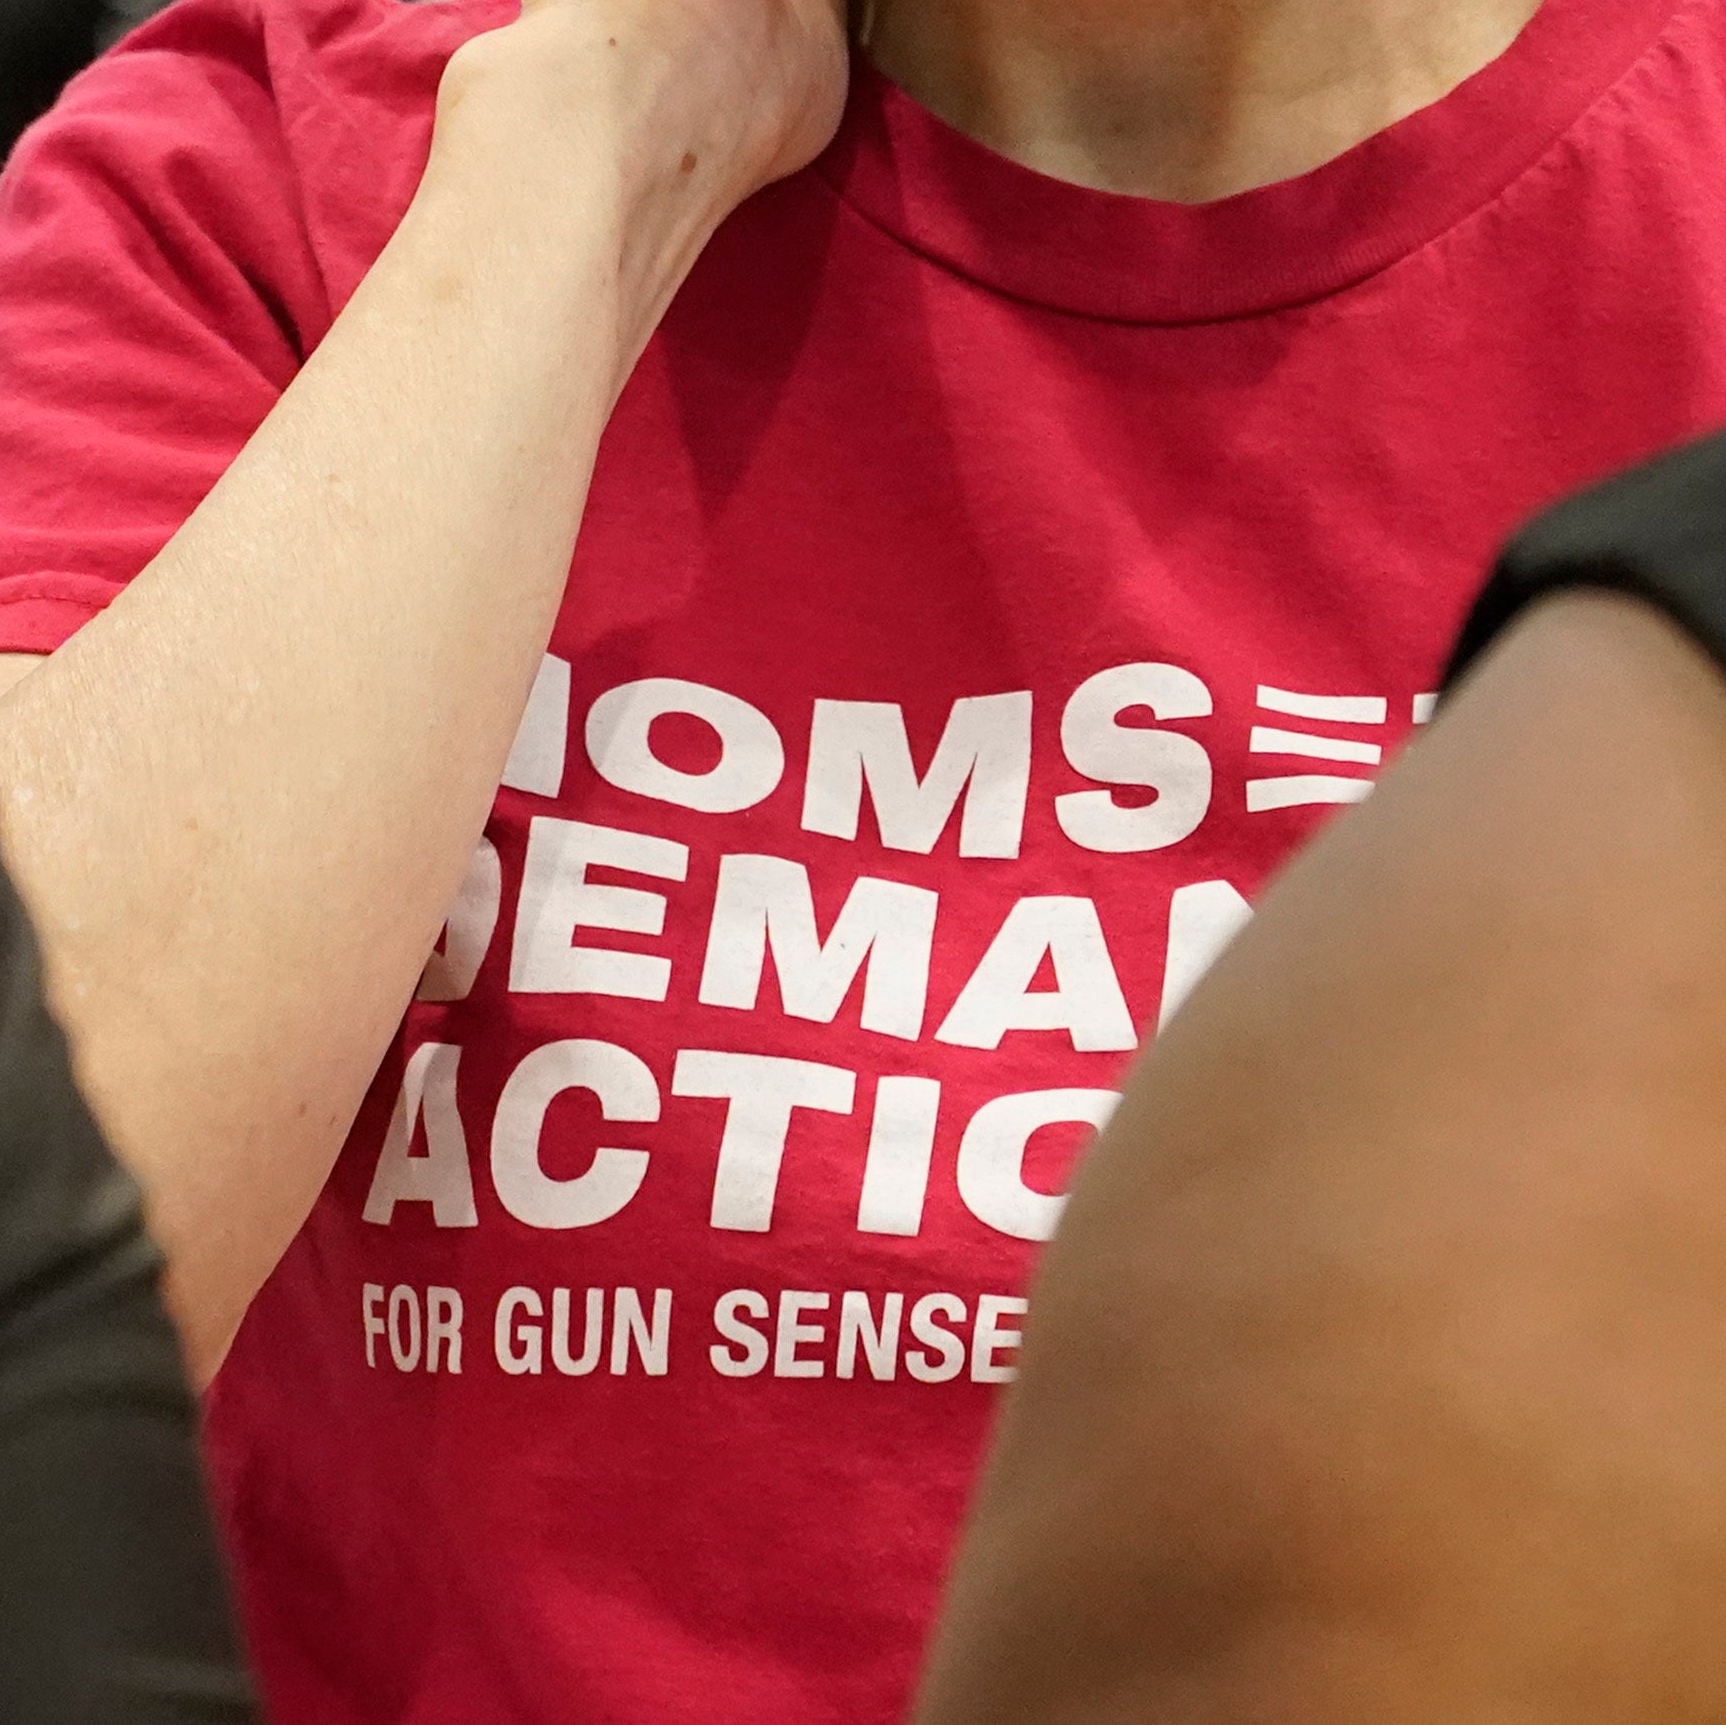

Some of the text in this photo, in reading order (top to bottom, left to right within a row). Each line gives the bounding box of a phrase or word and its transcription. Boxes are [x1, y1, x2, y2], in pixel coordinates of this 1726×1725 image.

[362, 1282, 1029, 1383] FOR GUN SENSE
